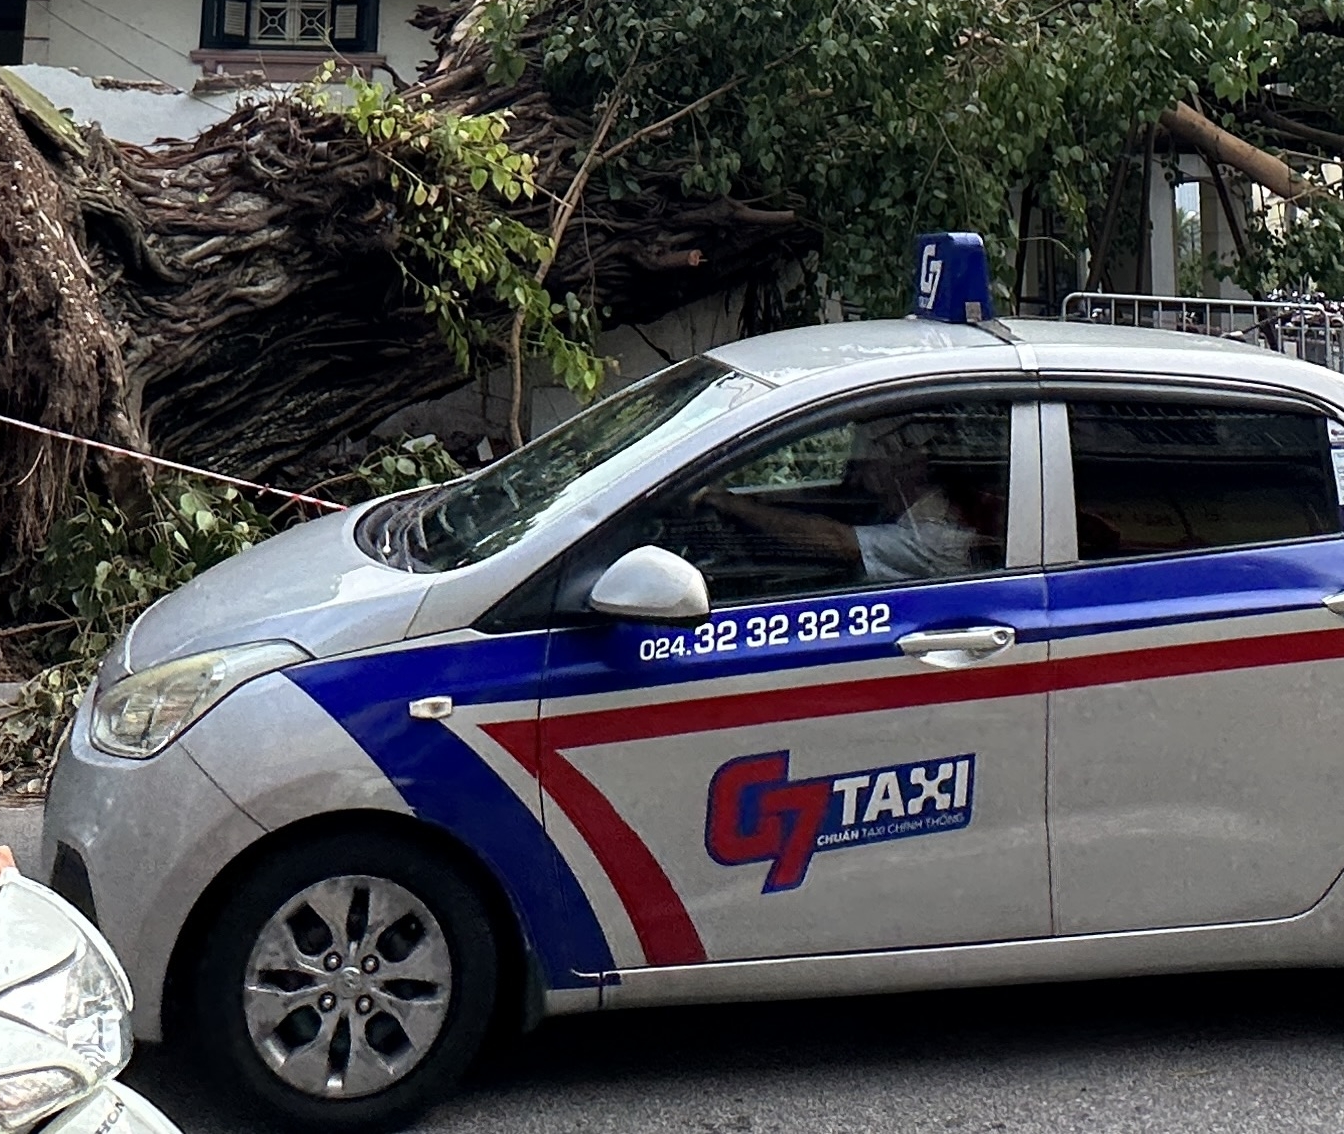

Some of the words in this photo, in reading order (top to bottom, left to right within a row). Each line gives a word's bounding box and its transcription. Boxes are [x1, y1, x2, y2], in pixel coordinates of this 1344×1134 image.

[639, 620, 738, 662] 024.32
[746, 614, 790, 648] 32
[798, 609, 840, 642] 32
[848, 603, 892, 636] 32
[707, 752, 833, 894] G7
[833, 759, 970, 827] TAXI
[861, 825, 886, 837] TAXI
